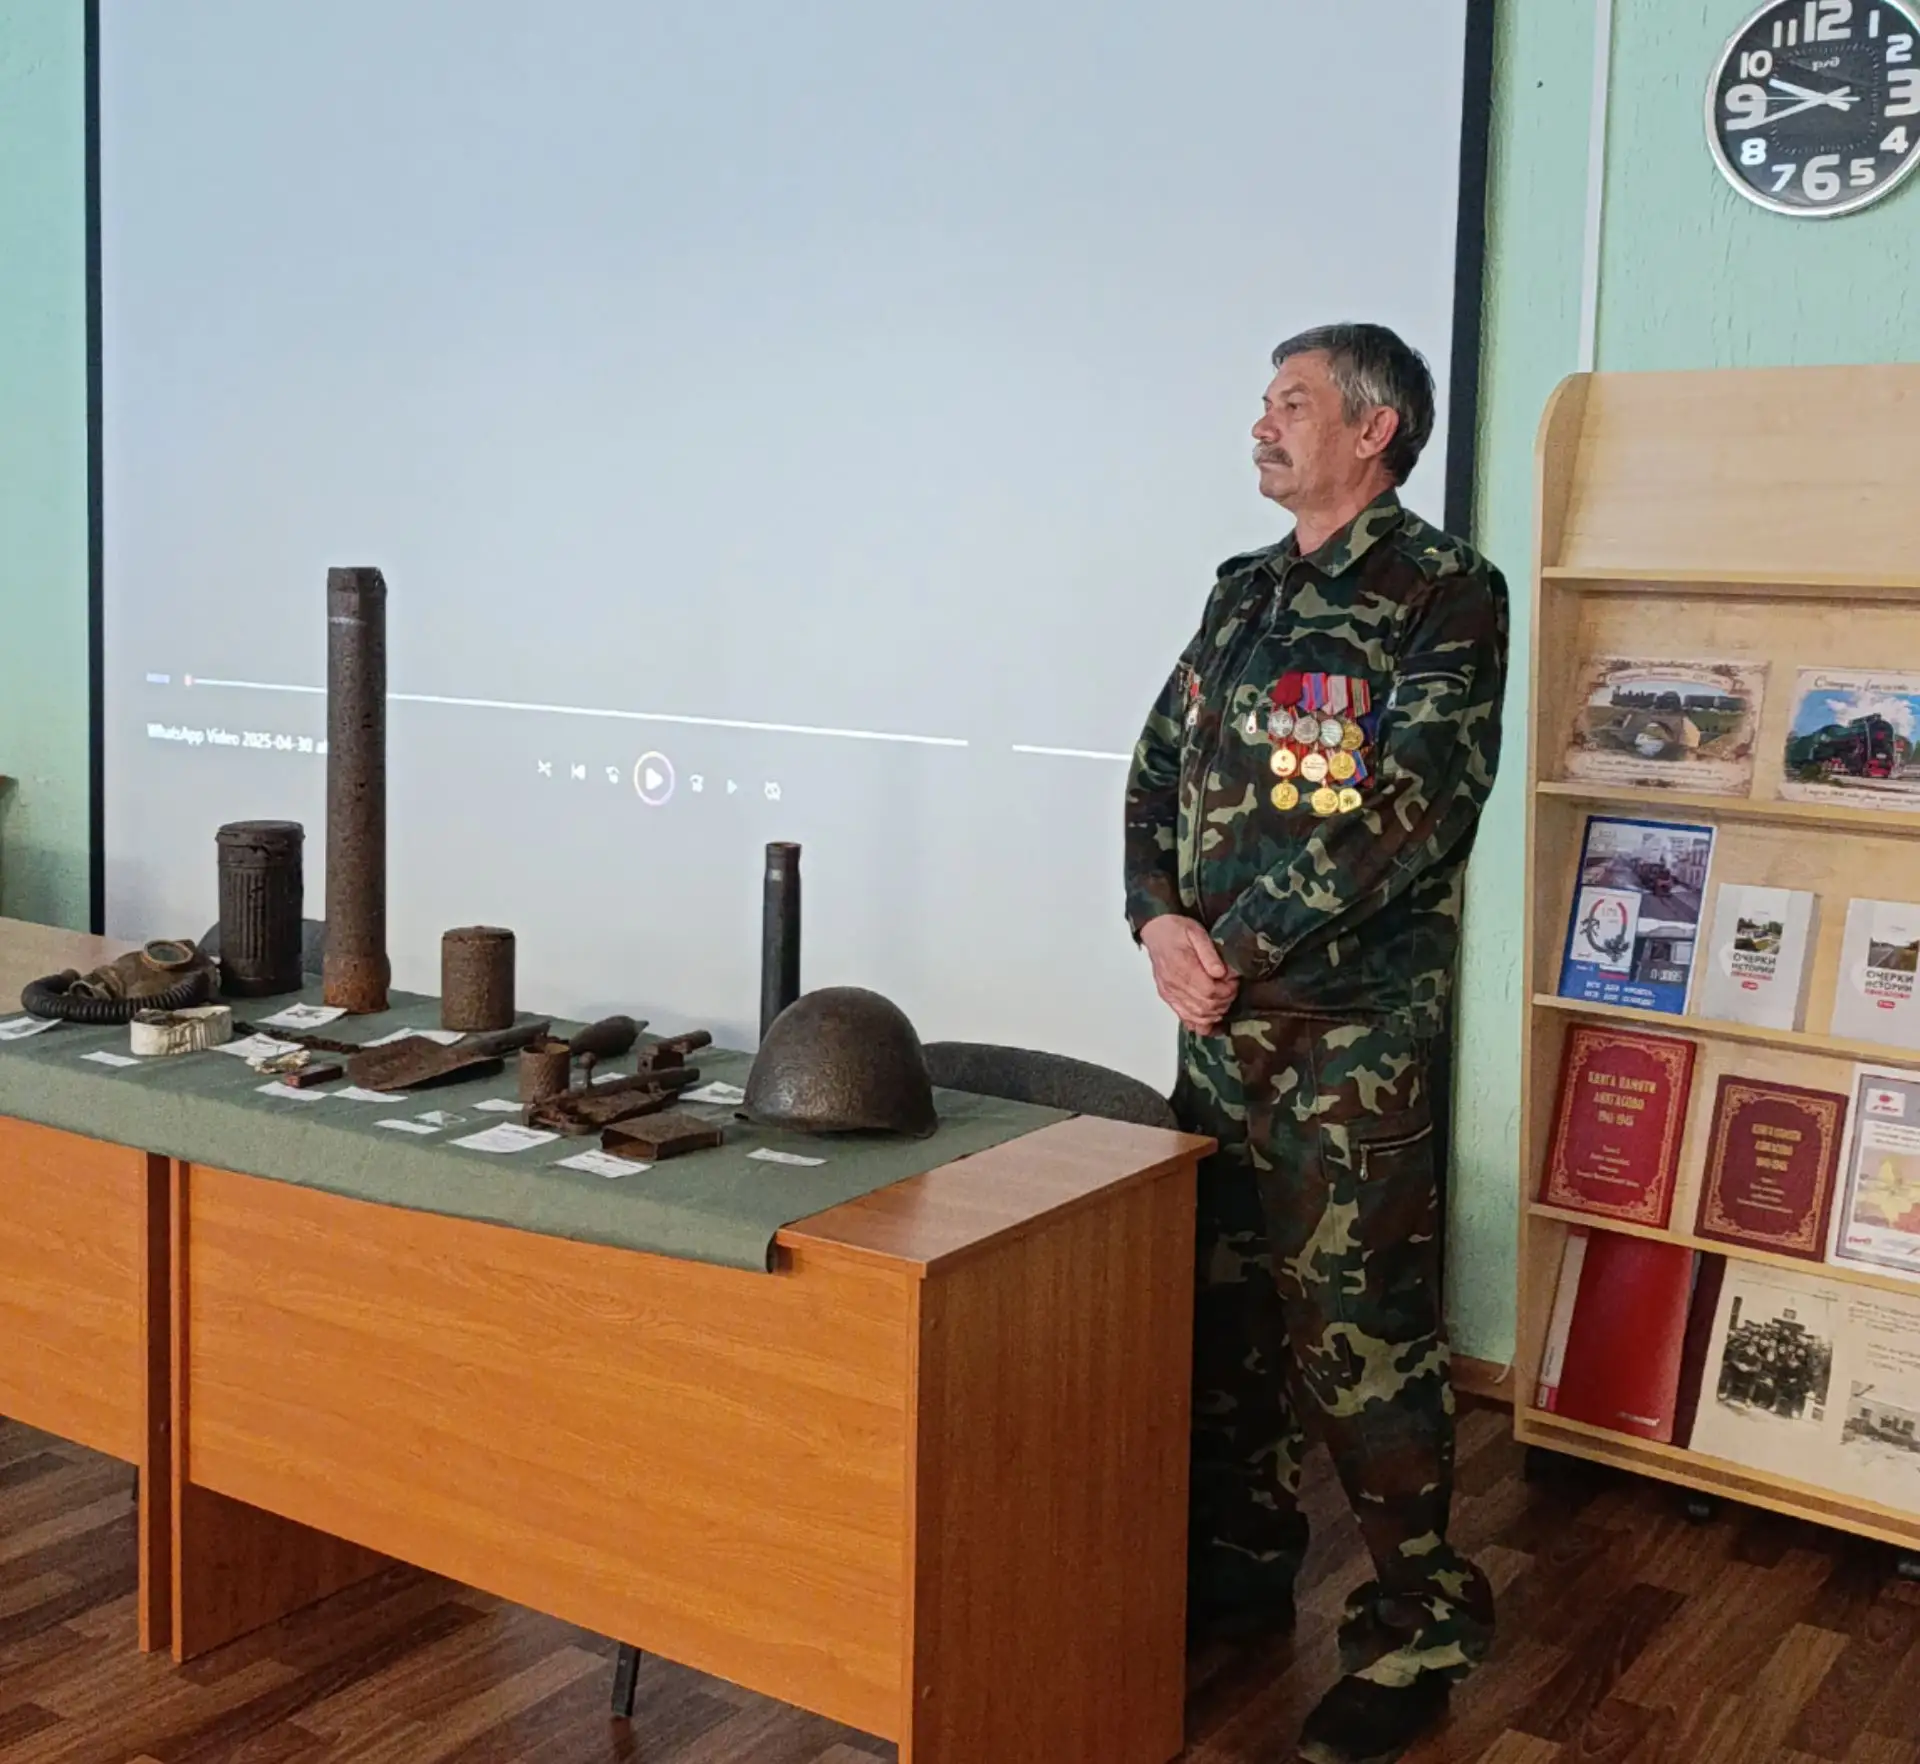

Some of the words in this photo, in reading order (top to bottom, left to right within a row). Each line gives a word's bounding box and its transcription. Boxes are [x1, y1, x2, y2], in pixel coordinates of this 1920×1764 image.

[1772, 19, 1797, 48] 11
[1803, 0, 1853, 43] 12
[1868, 10, 1880, 38] 1
[1886, 33, 1913, 63] 2
[1740, 50, 1773, 79] 10
[1725, 83, 1767, 131] 9
[1884, 68, 1920, 117] 3
[1740, 137, 1767, 165] 8
[1879, 126, 1909, 153] 4
[1770, 164, 1796, 192] 7
[1802, 154, 1841, 200] 6
[1849, 157, 1876, 186] 5
[147, 723, 204, 747] WhatsApp
[206, 727, 240, 747] Video
[242, 731, 314, 753] 2025-04-30
[1733, 952, 1776, 966] ОЧЕРКИ
[1866, 970, 1914, 984] ОЧЕРКИ
